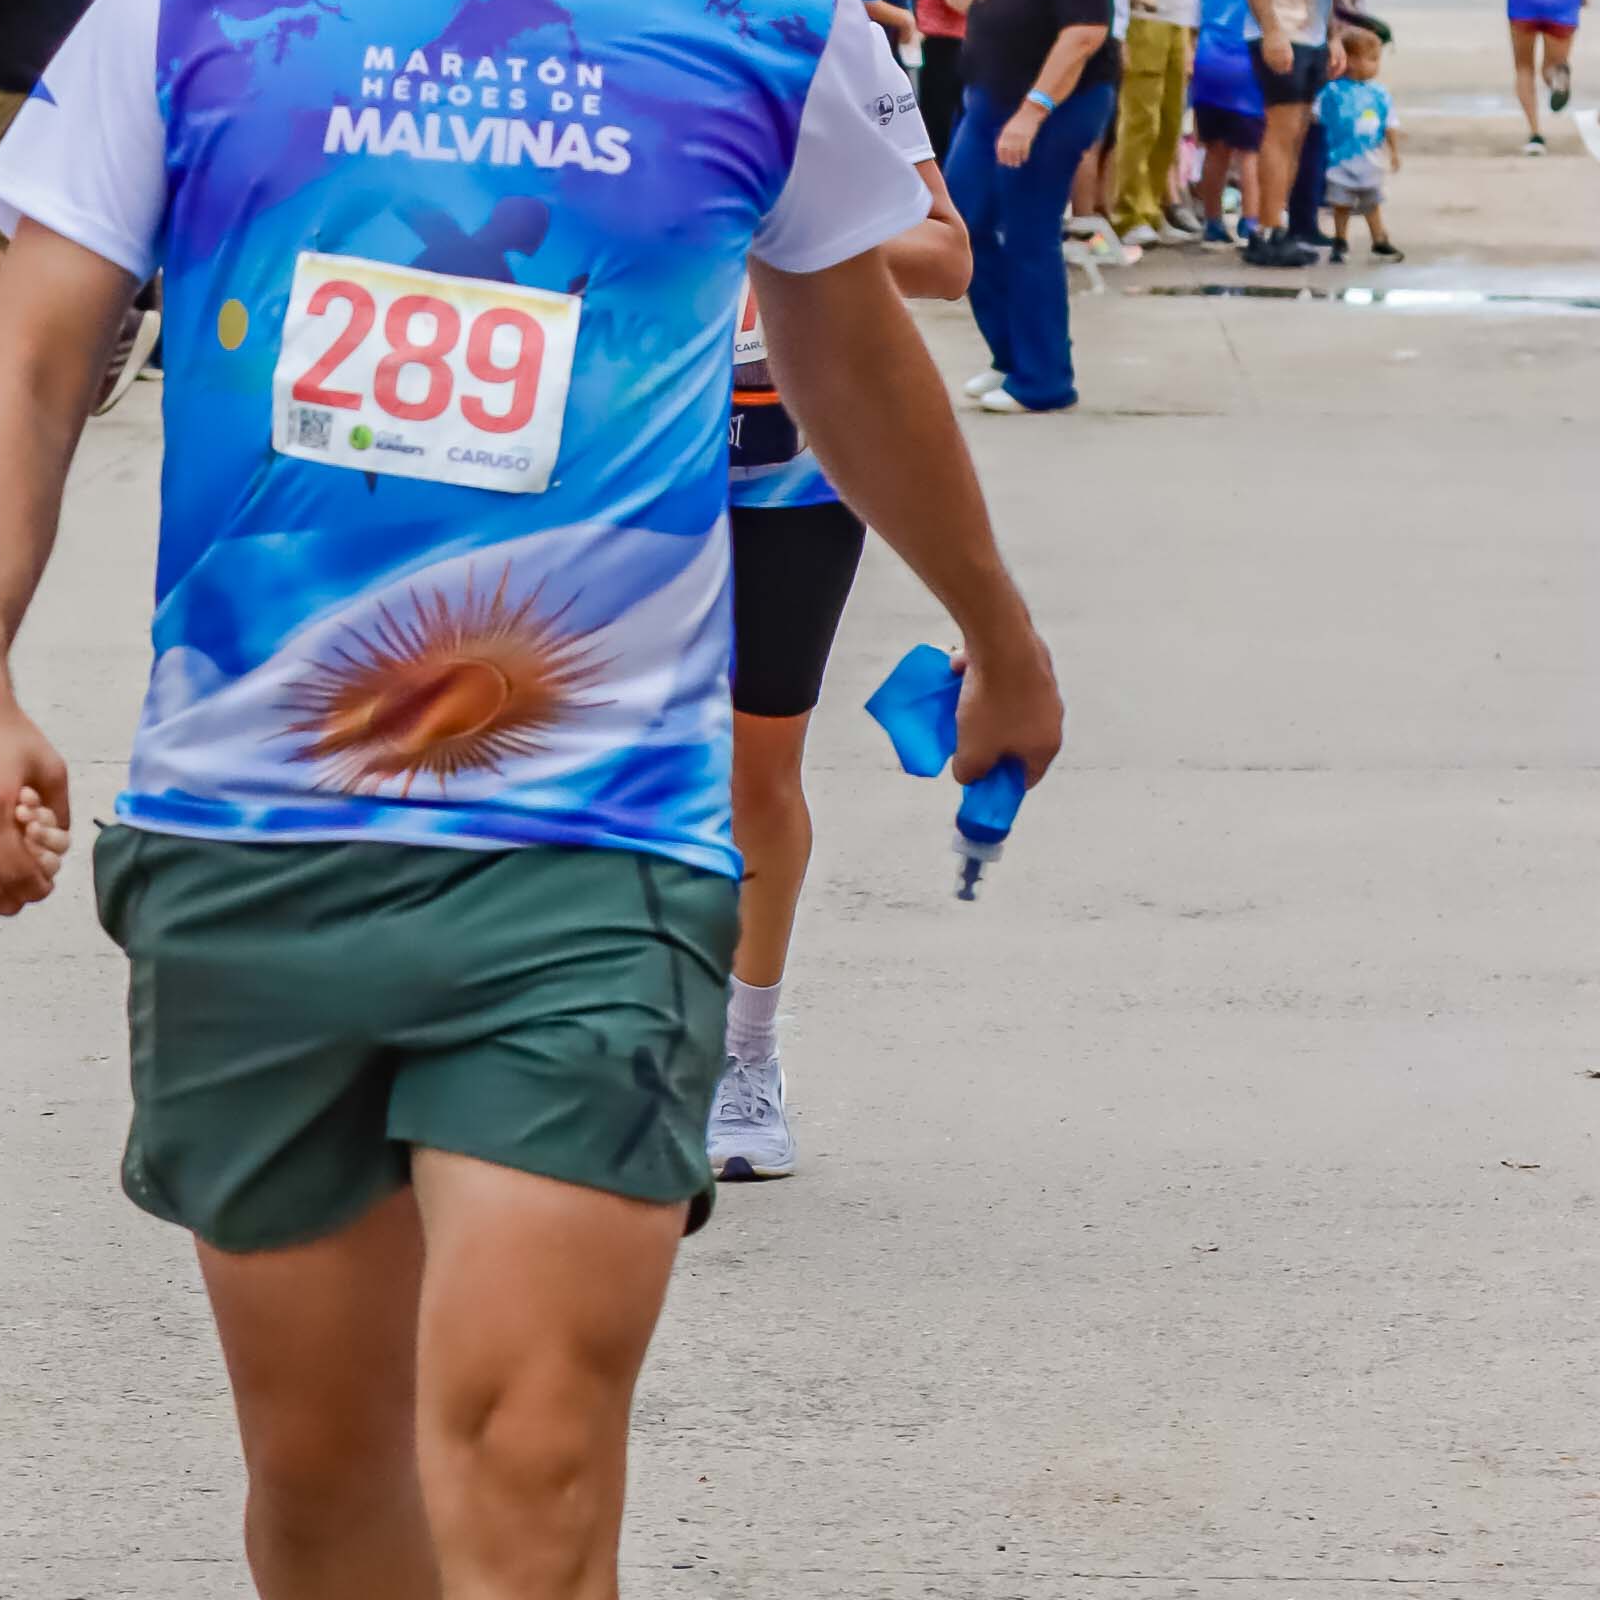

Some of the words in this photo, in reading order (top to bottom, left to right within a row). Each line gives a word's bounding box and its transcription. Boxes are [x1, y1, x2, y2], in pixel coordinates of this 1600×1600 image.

[363, 44, 604, 90] MARATÓN
[360, 74, 529, 111] HÉROES
[550, 90, 602, 116] DE
[323, 105, 632, 175] MALVINAS
[291, 279, 547, 435] 289
[446, 445, 531, 473] CARUSO
